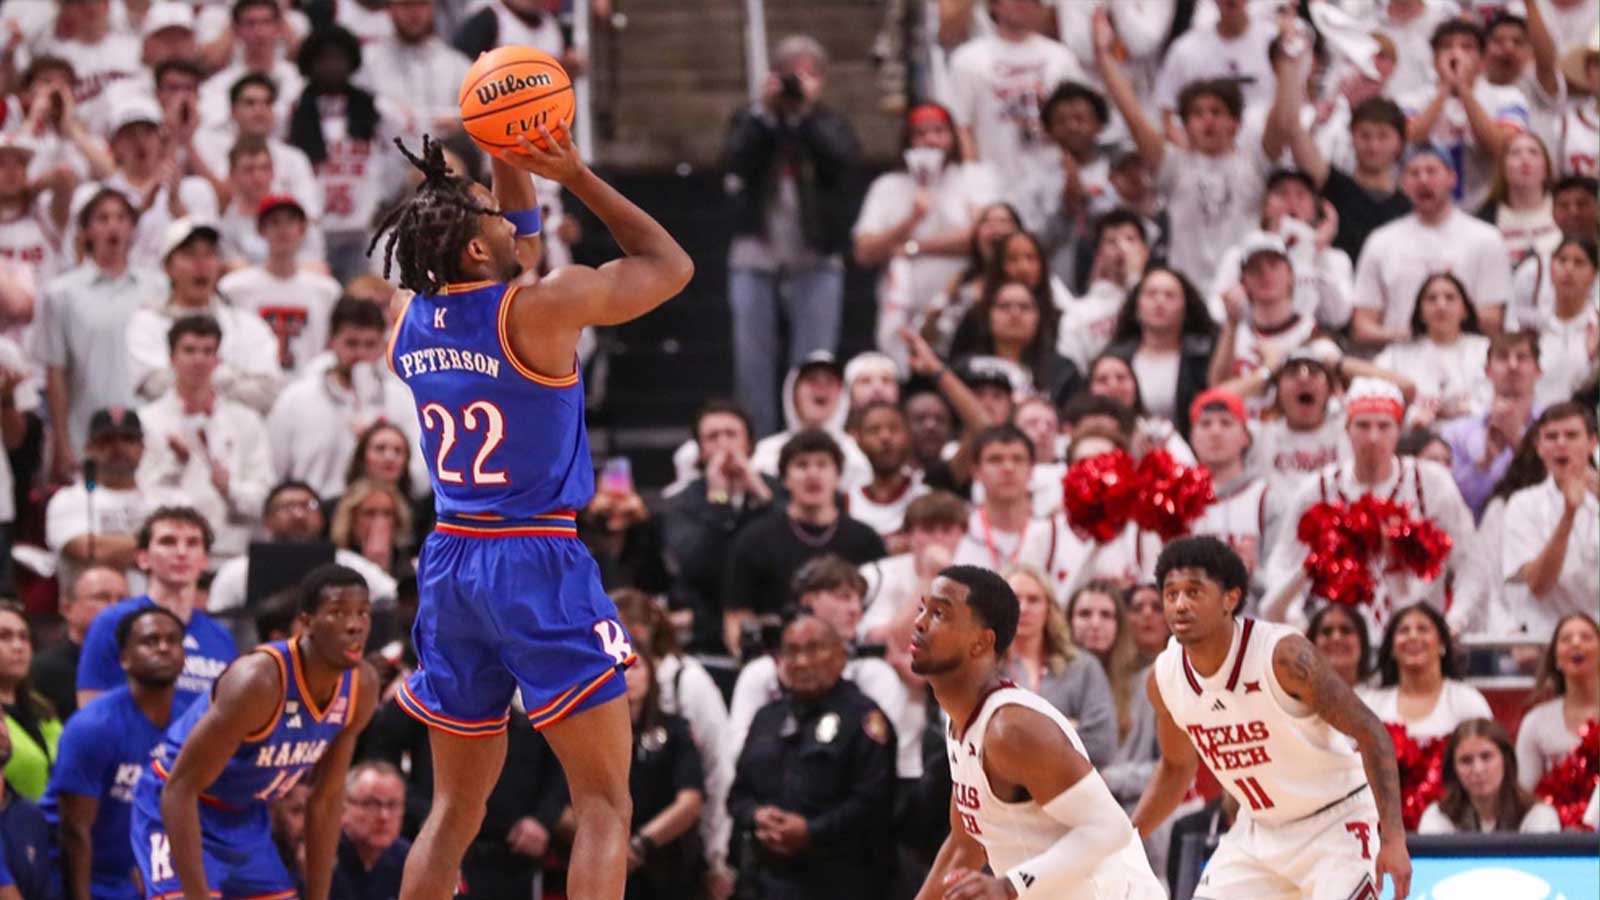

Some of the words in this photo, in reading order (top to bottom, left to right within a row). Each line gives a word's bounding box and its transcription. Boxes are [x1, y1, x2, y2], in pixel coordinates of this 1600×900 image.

[476, 74, 551, 105] Wilson
[433, 307, 447, 328] K
[399, 347, 500, 379] PETERSON
[420, 400, 512, 486] 22
[1186, 720, 1270, 747] TEXAS
[1202, 745, 1272, 771] TECH
[1234, 776, 1275, 811] 11
